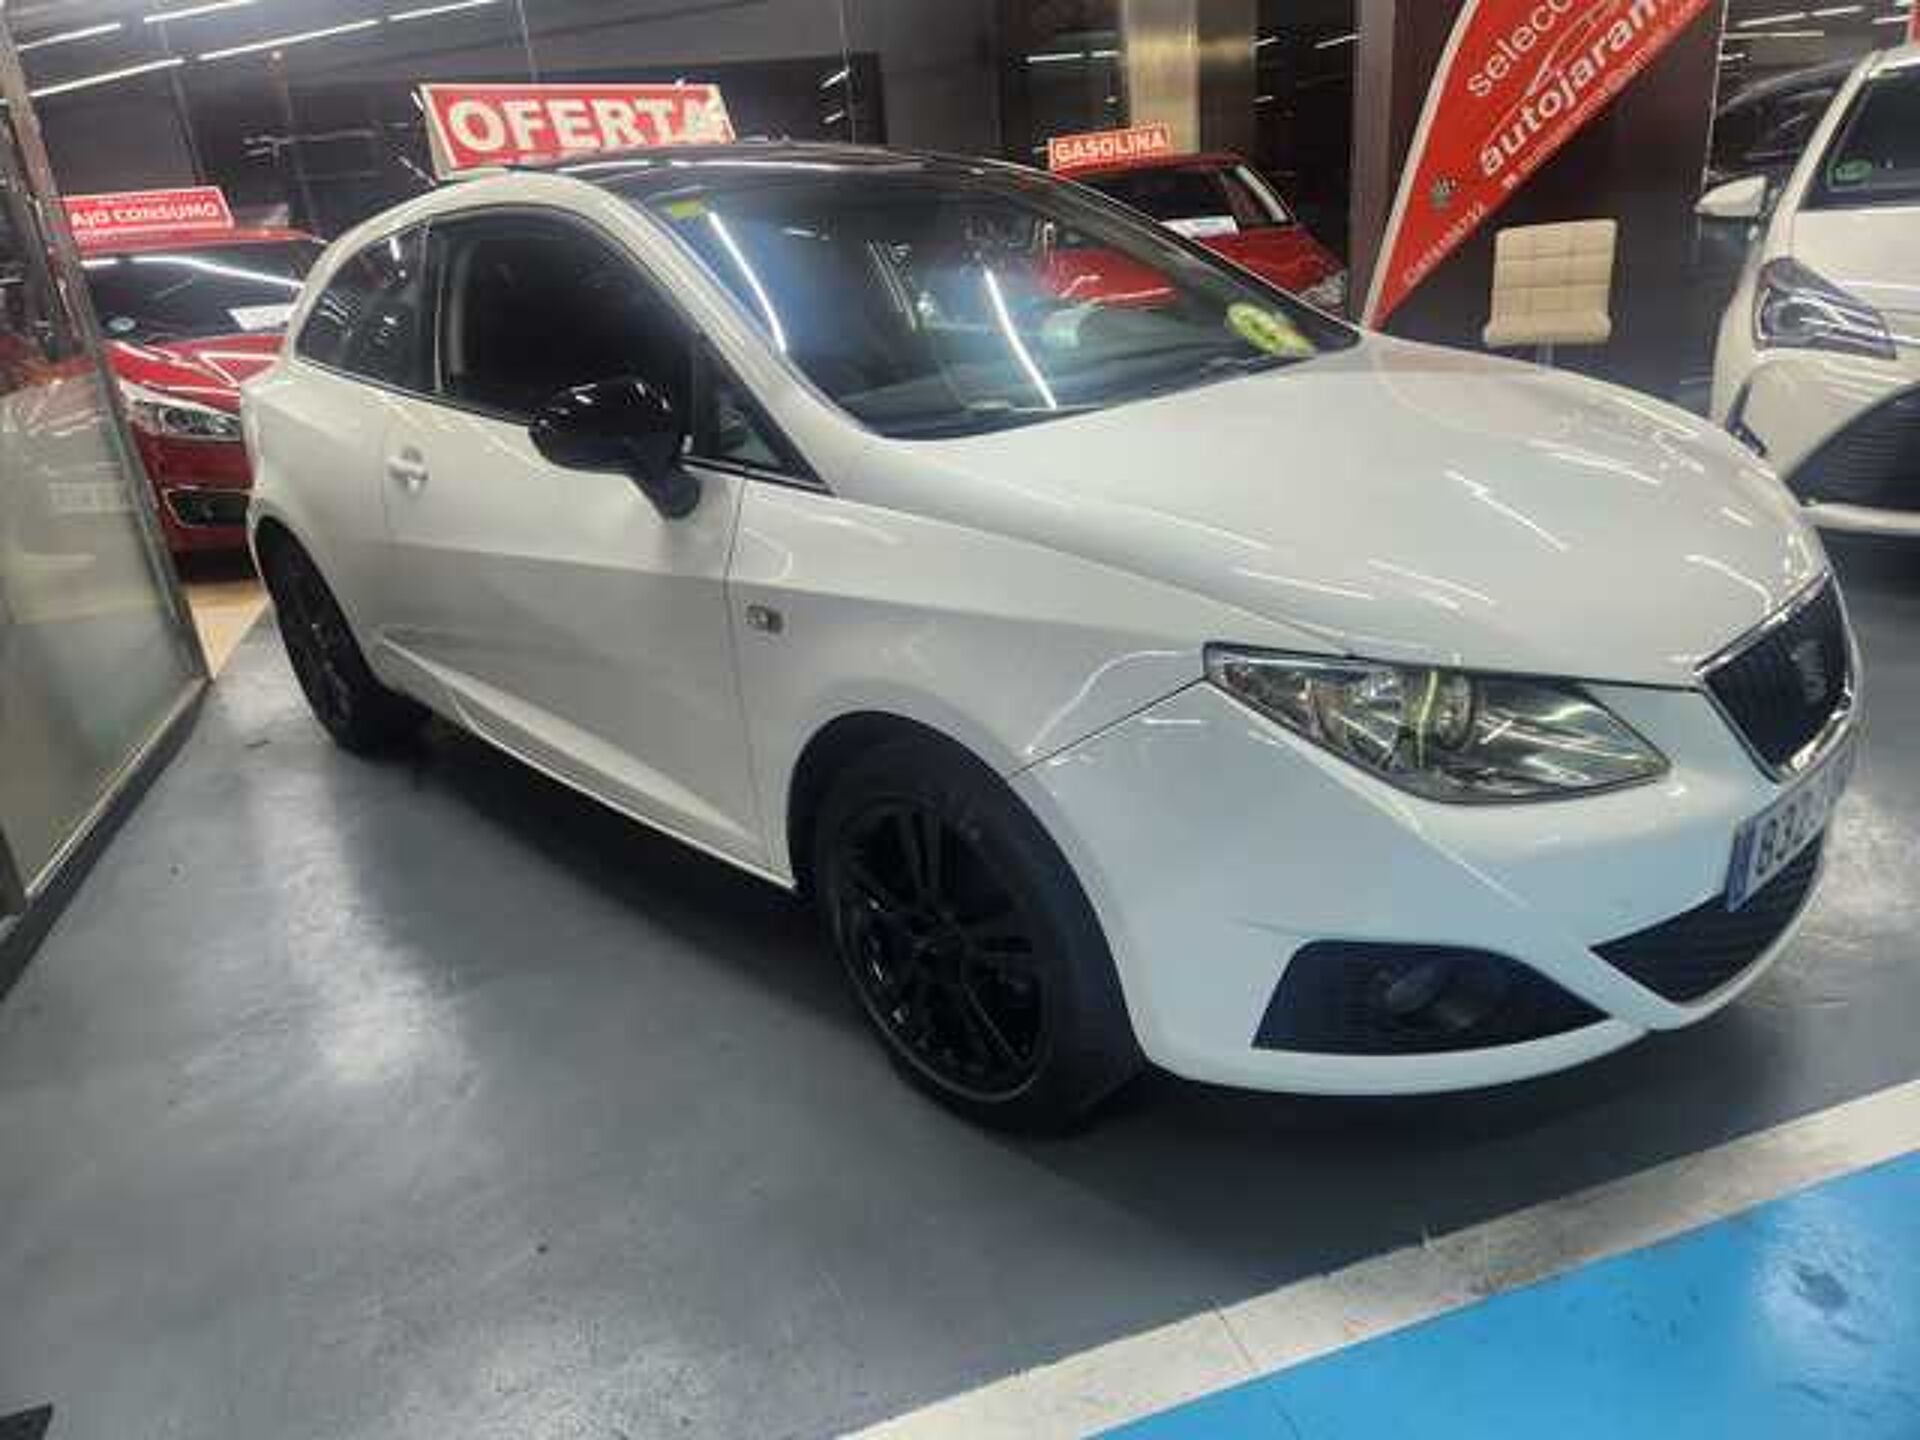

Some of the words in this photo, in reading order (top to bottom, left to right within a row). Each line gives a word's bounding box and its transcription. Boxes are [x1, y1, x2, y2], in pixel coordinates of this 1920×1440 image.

[450, 98, 730, 152] OFERTA
[1055, 126, 1170, 161] GASOLINA
[71, 207, 110, 228] AJO
[113, 201, 219, 223] CONSUMO
